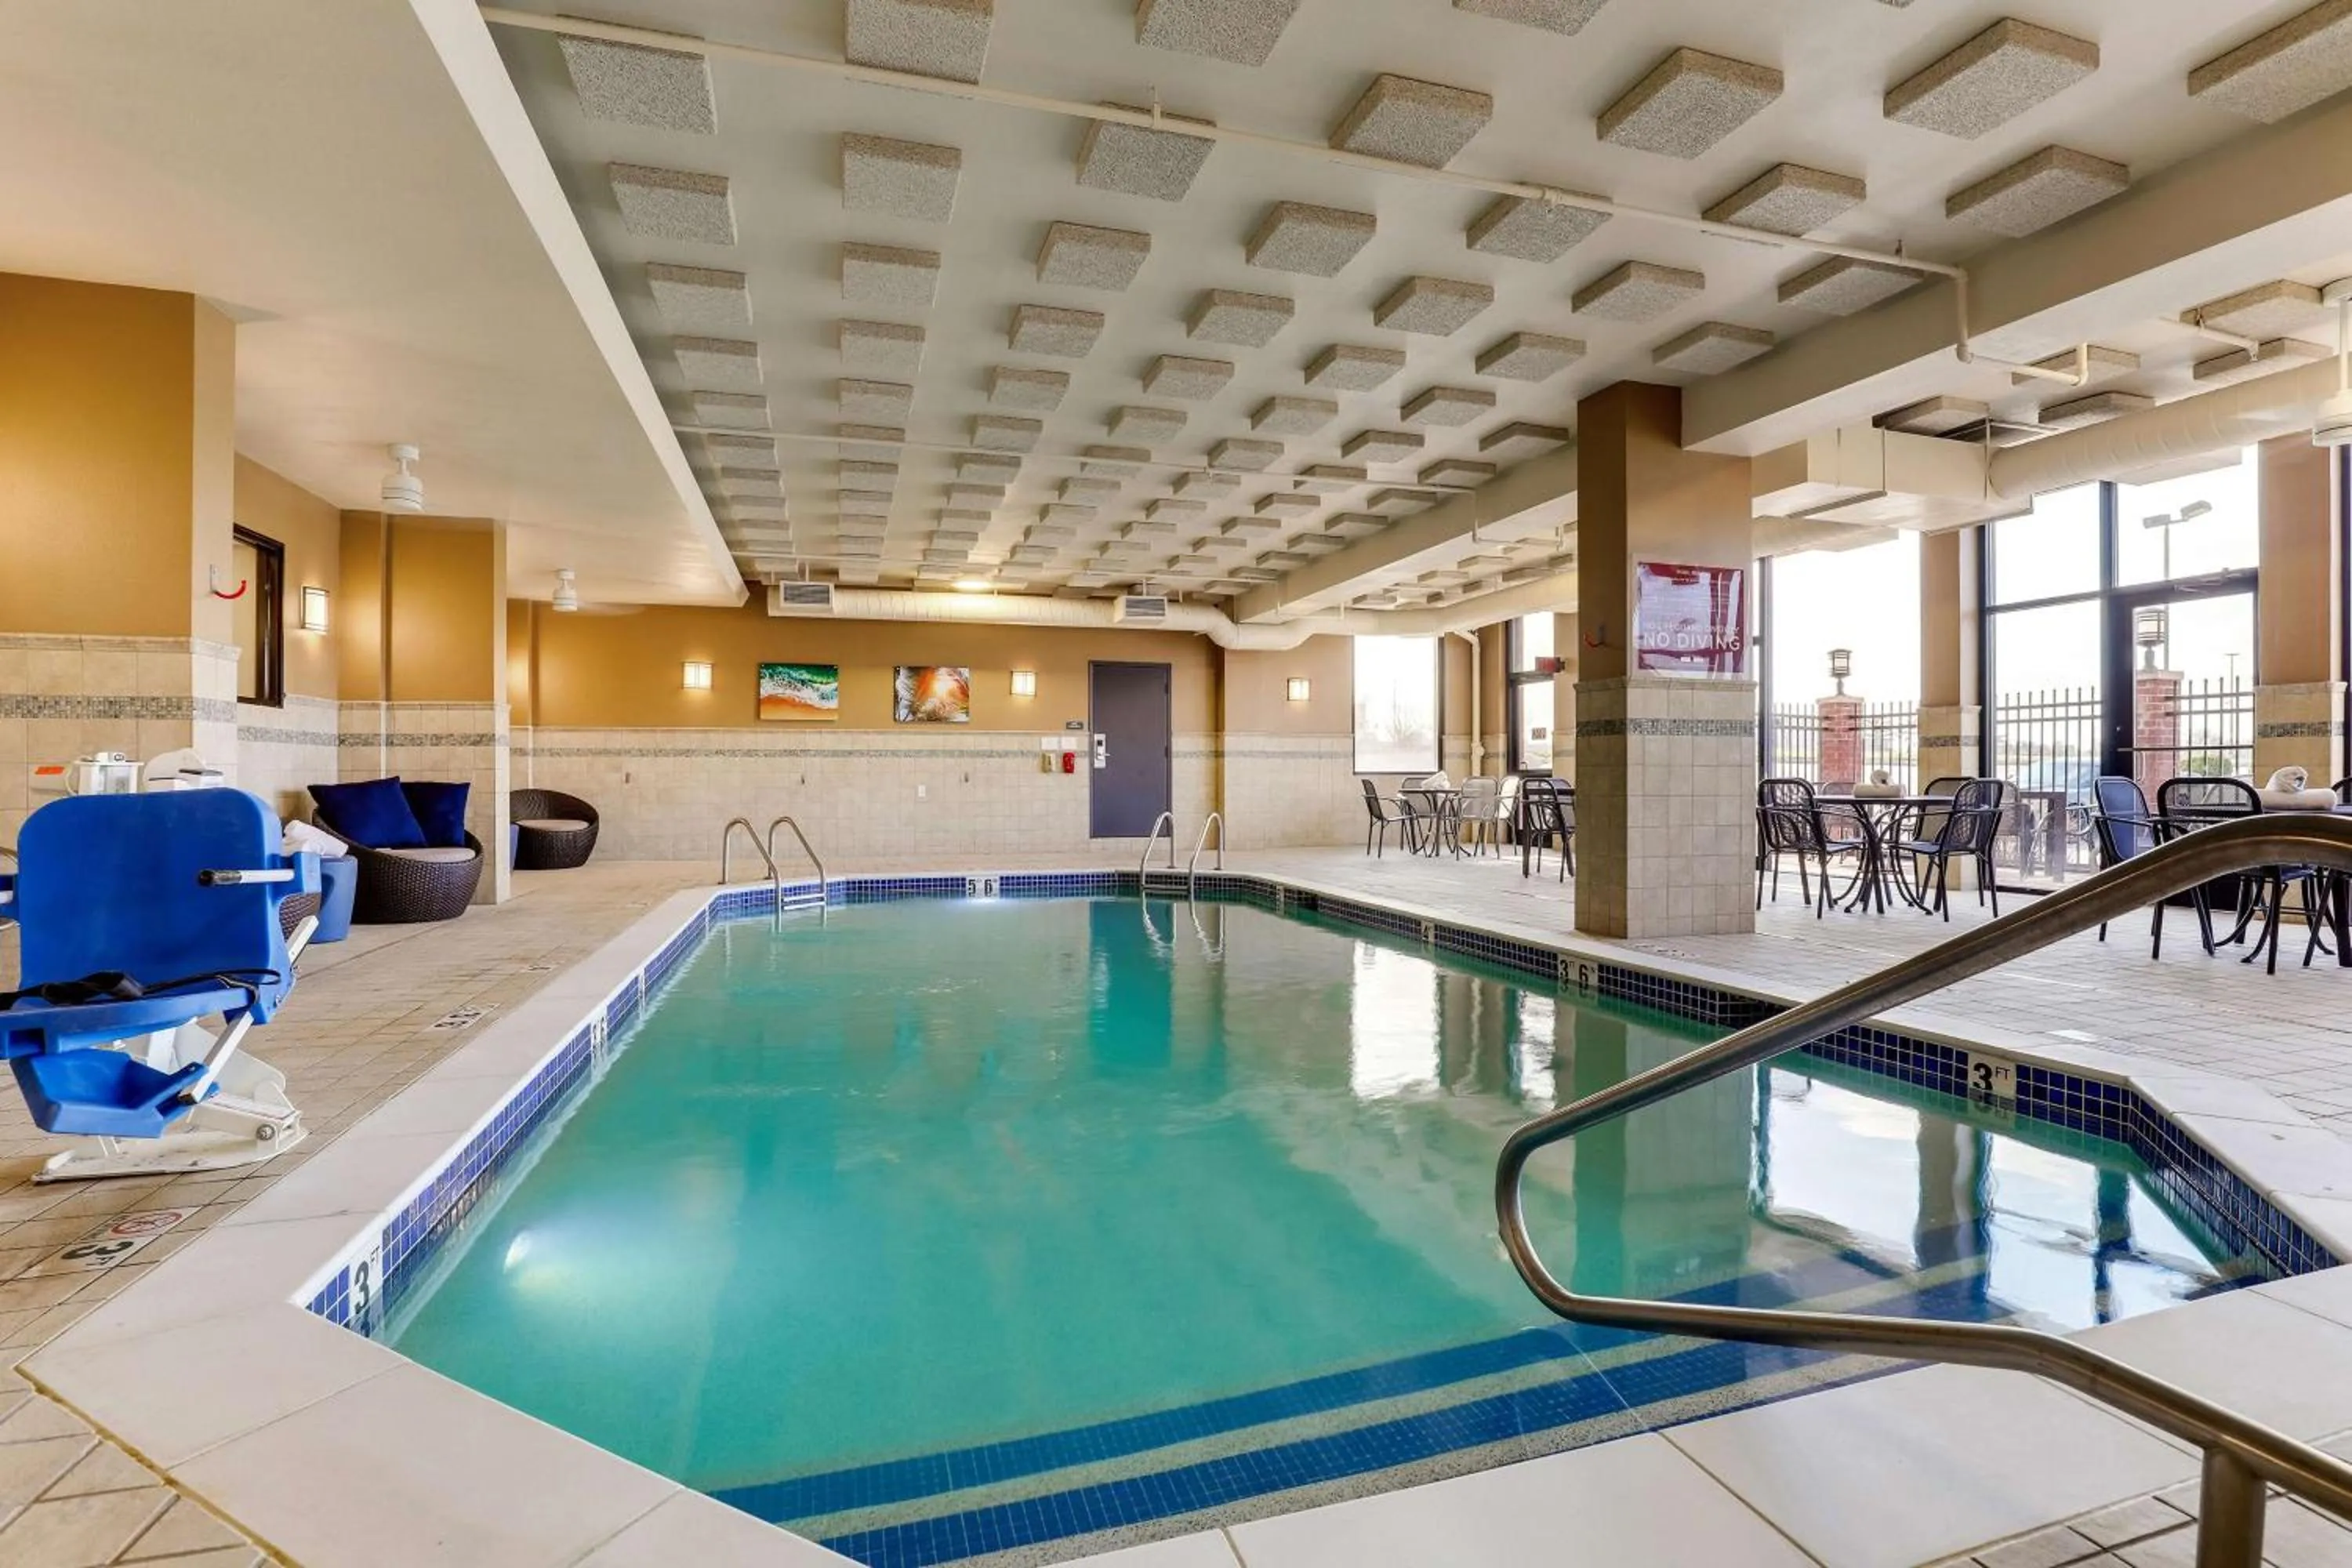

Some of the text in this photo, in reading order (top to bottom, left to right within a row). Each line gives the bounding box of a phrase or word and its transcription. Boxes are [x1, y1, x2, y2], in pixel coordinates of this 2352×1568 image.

[1643, 632, 1740, 652] NO DIVING
[1559, 959, 1568, 978] 3
[1579, 964, 1589, 983] 6
[1973, 1062, 2010, 1091] 3 FT
[354, 1260, 370, 1315] 3
